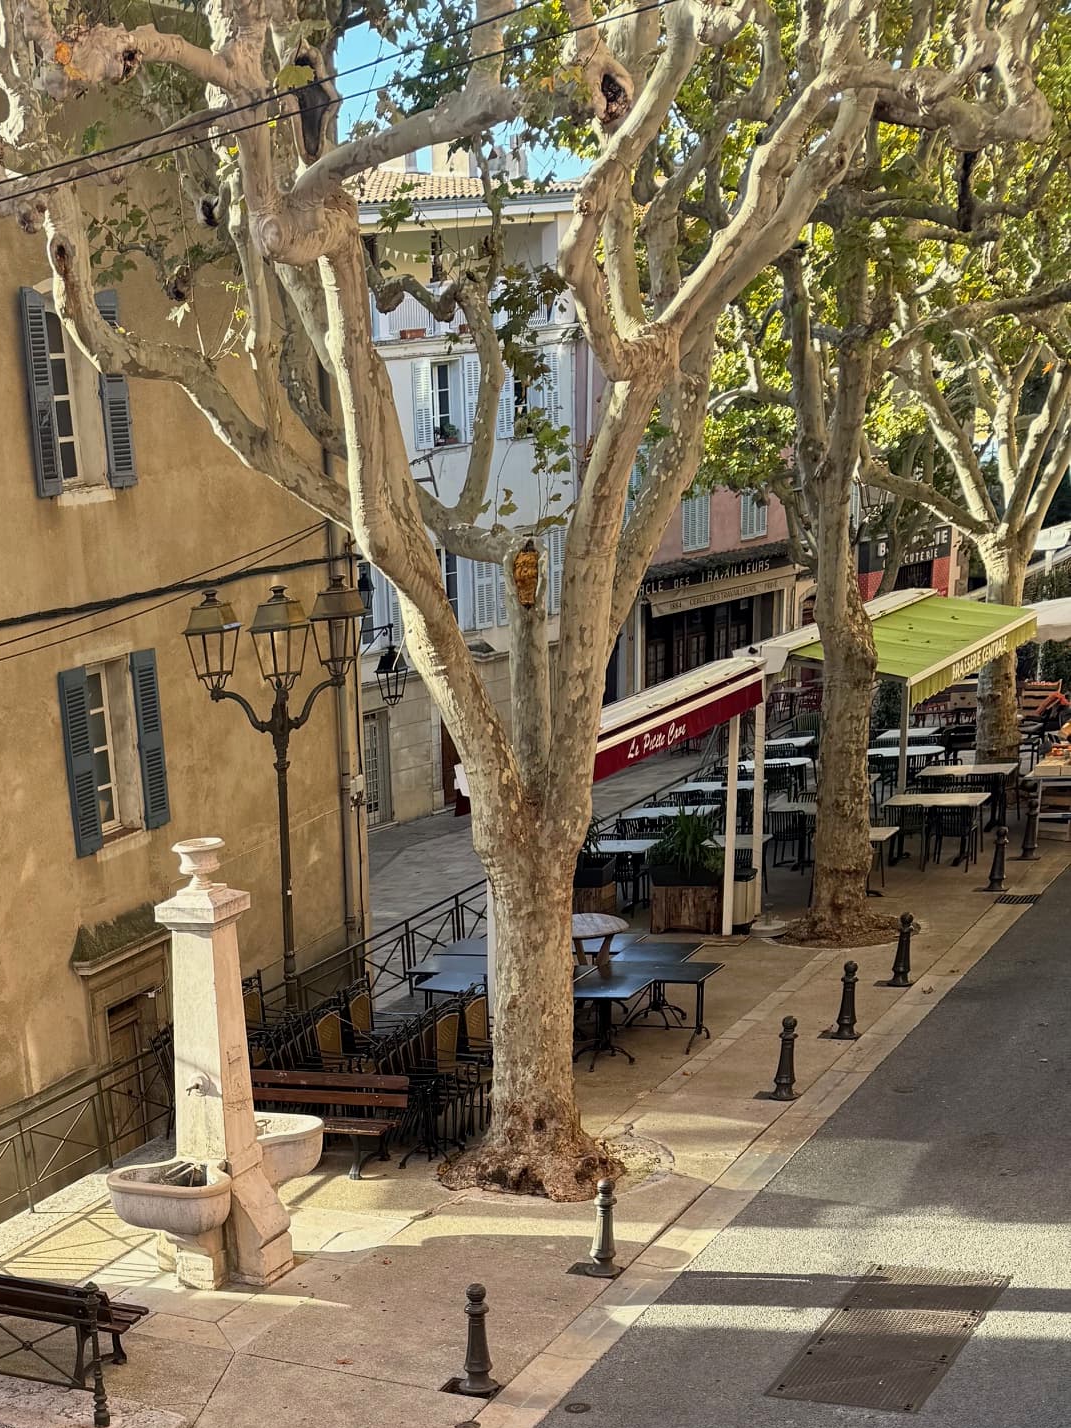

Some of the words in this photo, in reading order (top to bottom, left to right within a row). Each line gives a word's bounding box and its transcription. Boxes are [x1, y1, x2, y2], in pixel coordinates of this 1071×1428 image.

[638, 580, 664, 596] RCLE
[673, 576, 690, 589] DES
[982, 635, 1008, 662] CENTRALE
[668, 722, 686, 745] Cave
